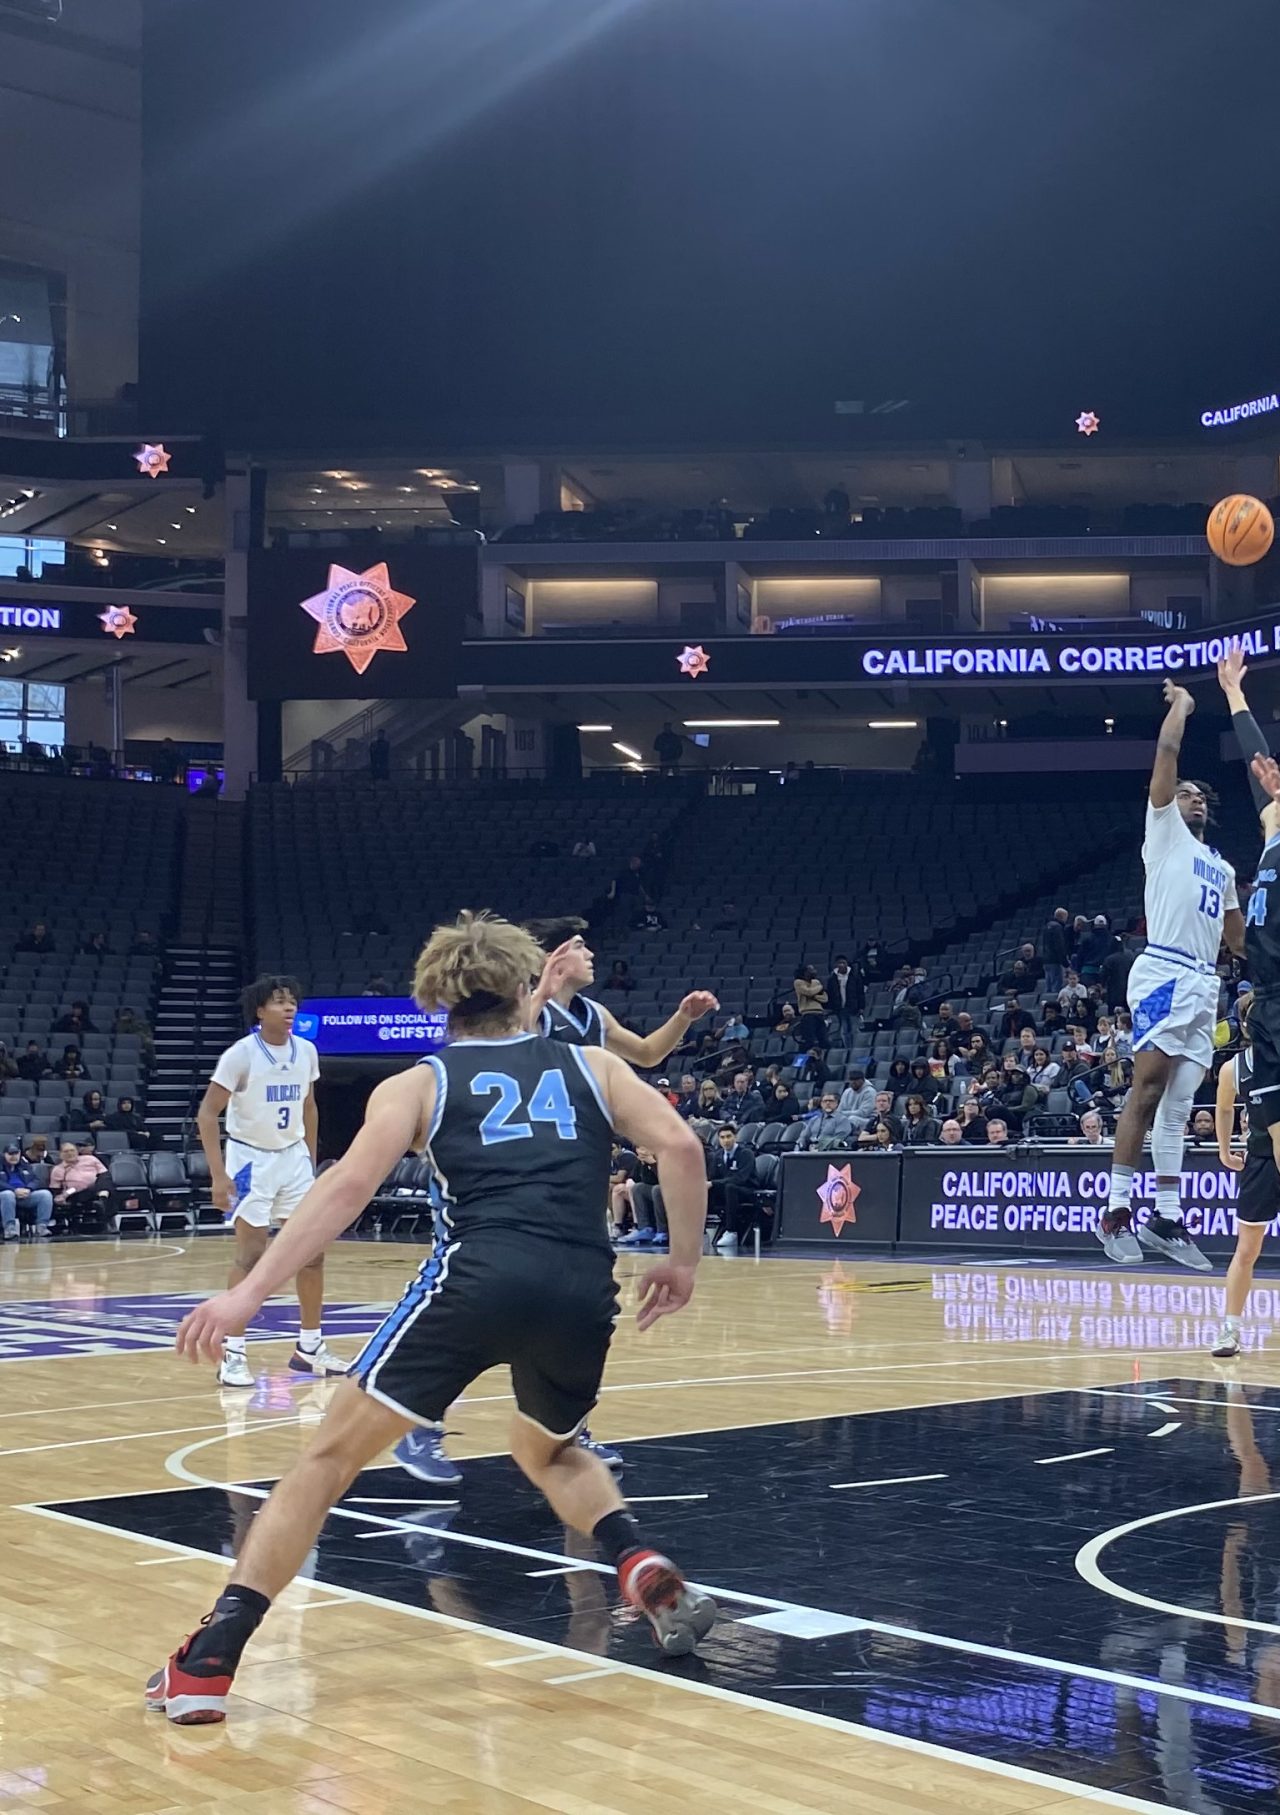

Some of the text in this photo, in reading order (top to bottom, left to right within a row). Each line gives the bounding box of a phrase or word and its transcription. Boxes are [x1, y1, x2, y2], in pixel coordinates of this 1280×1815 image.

[1201, 394, 1279, 427] CALIFORNIA
[862, 647, 1051, 674] CALIFORNIA
[1059, 632, 1268, 673] CORRECTIONAL
[1193, 856, 1226, 893] WILDCATS
[1198, 884, 1220, 919] 13
[322, 1014, 363, 1026] FOLLOW
[363, 1014, 377, 1025] US
[379, 1014, 393, 1025] ON
[395, 1013, 429, 1025] SOCIAL
[378, 1026, 447, 1041] @CIFSTA
[266, 1084, 301, 1102] WILDCATS
[469, 1068, 578, 1146] 24
[277, 1106, 290, 1130] 3
[942, 1170, 1072, 1199] CALIFORNIA
[930, 1203, 998, 1231] PEACE
